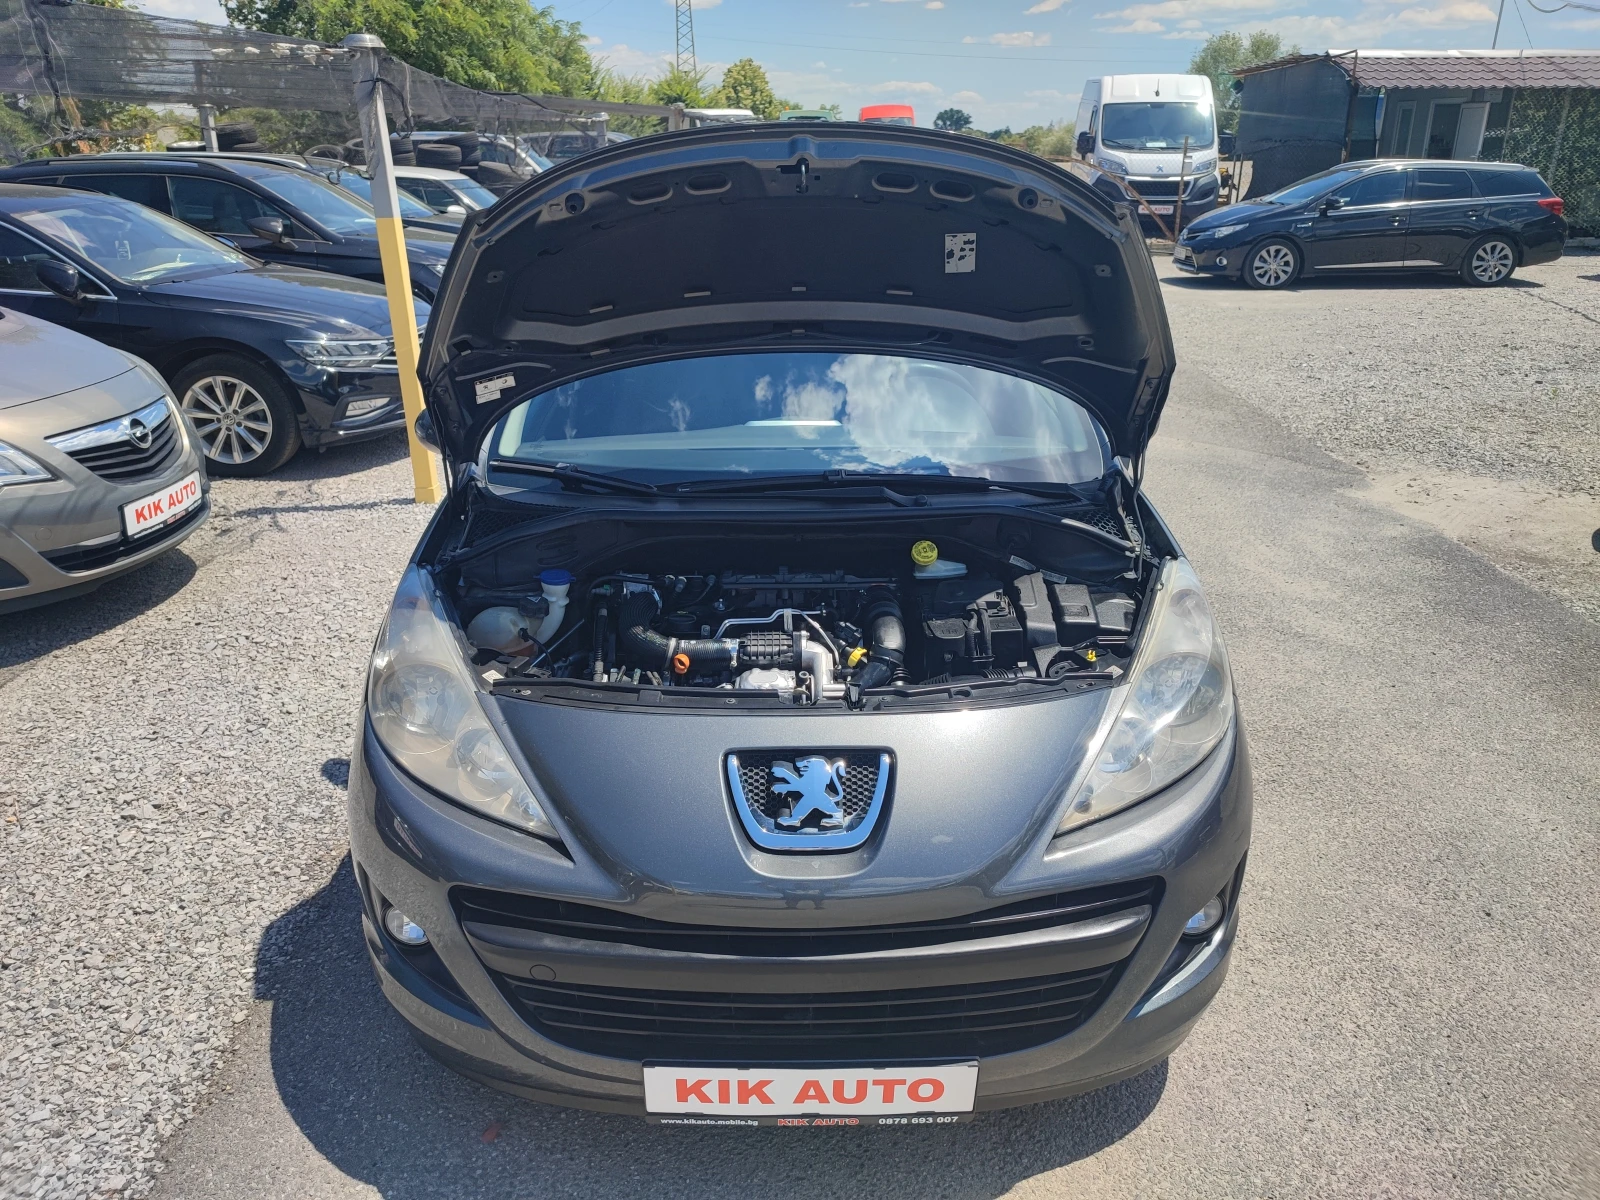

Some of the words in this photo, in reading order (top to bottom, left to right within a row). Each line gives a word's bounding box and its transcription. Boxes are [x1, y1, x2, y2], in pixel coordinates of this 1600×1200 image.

[135, 498, 164, 524] KIK
[168, 480, 196, 510] AUTO
[675, 1078, 776, 1105] KIK
[792, 1077, 945, 1105] AUTO
[660, 1118, 759, 1127] www.kikauto.mobile.bg
[777, 1118, 810, 1126] KIK
[812, 1117, 860, 1126] AUTO
[878, 1117, 908, 1125] 0878
[911, 1117, 934, 1125] 693
[936, 1116, 959, 1124] 007
